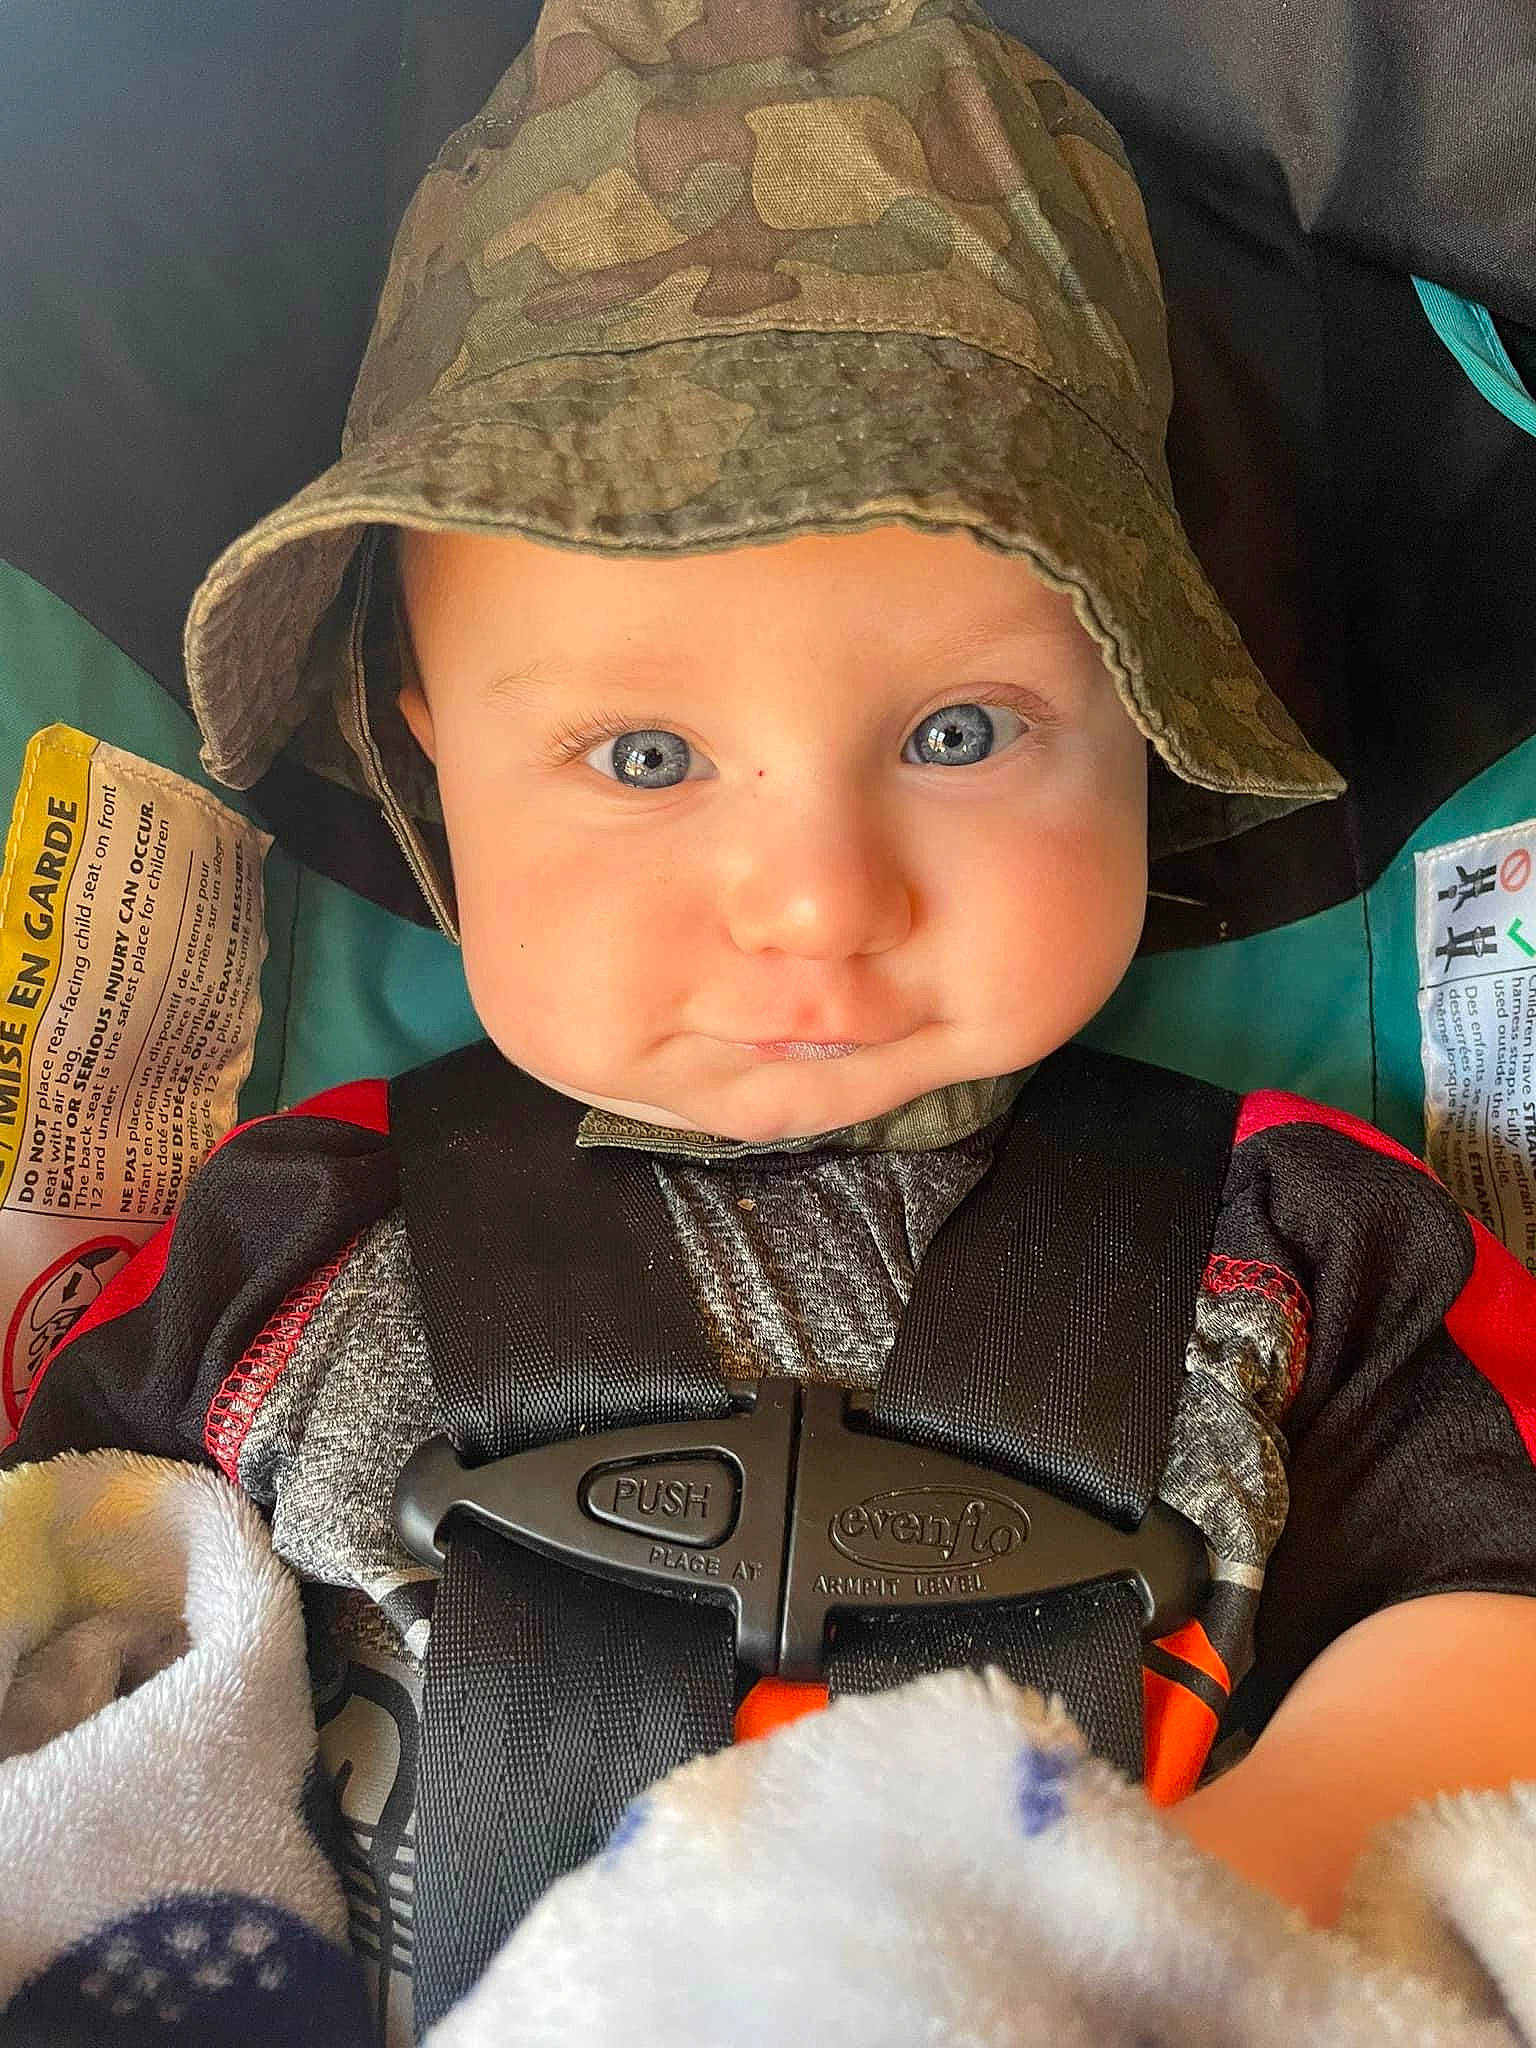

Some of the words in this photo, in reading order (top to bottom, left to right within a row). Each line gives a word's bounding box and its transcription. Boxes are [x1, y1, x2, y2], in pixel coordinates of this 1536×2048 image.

[98, 785, 117, 830] front
[96, 835, 109, 858] on
[130, 801, 154, 874] OCCUR.
[147, 819, 169, 890] children
[24, 796, 77, 941] GARDE
[83, 863, 102, 901] seat
[199, 861, 210, 901] pour
[119, 880, 139, 923] CAN
[139, 894, 156, 920] for
[211, 879, 221, 900] un
[74, 904, 91, 950] child
[185, 903, 204, 964] retenue
[208, 904, 218, 929] sur
[104, 930, 129, 1001] INJURY
[132, 924, 150, 974] place
[189, 933, 213, 991] l'arrière
[7, 953, 50, 1009] EN
[177, 968, 190, 989] de
[215, 938, 238, 1007] GRAVES
[48, 957, 91, 1054] rear-facing
[117, 975, 140, 1027] safest
[182, 981, 216, 1054] gonflable.
[229, 989, 240, 1008] de
[1465, 986, 1479, 1016] Des
[1495, 980, 1509, 1018] used
[1511, 977, 1524, 1040] harness
[149, 992, 183, 1063] dispositif
[171, 1010, 191, 1041] face
[204, 1009, 221, 1033] DE
[216, 1012, 233, 1044] plus
[231, 1024, 241, 1045] ou
[73, 1007, 112, 1092] SERIOUS
[103, 1031, 122, 1060] the
[190, 1036, 208, 1060] OU
[205, 1045, 217, 1060] le
[1449, 989, 1472, 1072] desserrées
[1462, 1078, 1470, 1098] ou
[1471, 1022, 1486, 1082] enfants
[1494, 1024, 1506, 1086] outside
[0, 1021, 27, 1125] MISE
[37, 1060, 54, 1111] place
[55, 1046, 81, 1085] bag.
[96, 1066, 110, 1079] is
[141, 1066, 152, 1088] un
[169, 1058, 183, 1083] sac
[192, 1061, 209, 1097] offre
[204, 1075, 219, 1093] 12
[1444, 1048, 1456, 1107] lorsque
[1505, 1046, 1517, 1101] straps.
[1522, 1053, 1534, 1095] have
[52, 1090, 65, 1114] air
[86, 1084, 104, 1121] seat
[145, 1044, 176, 1132] orientation
[159, 1087, 173, 1124] d'un
[173, 1063, 194, 1118] DÉCÈS
[201, 1099, 210, 1116] de
[1472, 1088, 1481, 1105] se
[1491, 1092, 1504, 1118] the
[66, 1097, 81, 1128] OR
[98, 1085, 120, 1140] under.
[127, 1090, 143, 1142] placer
[187, 1109, 199, 1152] arrière
[1505, 1108, 1520, 1148] Fully
[29, 1114, 46, 1162] NOT
[50, 1120, 62, 1162] with
[78, 1126, 92, 1169] back
[144, 1136, 153, 1156] en
[157, 1127, 168, 1166] doté
[172, 1122, 183, 1147] DE
[58, 1135, 76, 1208] DEATH
[94, 1146, 106, 1182] and
[124, 1146, 137, 1183] PAS
[1492, 1124, 1509, 1188] vehicle.
[17, 1170, 39, 1203] DO
[42, 1167, 59, 1206] seat
[74, 1174, 89, 1210] The
[90, 1187, 103, 1210] 12
[119, 1189, 133, 1213] NE
[136, 1161, 152, 1214] enfant
[150, 1172, 167, 1215] avant
[162, 1152, 183, 1216] RISQUE
[1511, 1153, 1534, 1216] restrain
[613, 1477, 712, 1518] PUSH
[840, 1501, 1018, 1560] evenflo
[649, 1545, 720, 1576] PLACE
[732, 1559, 763, 1580] AT
[812, 1575, 901, 1595] ARMPIT
[915, 1575, 987, 1595] LEVEL
